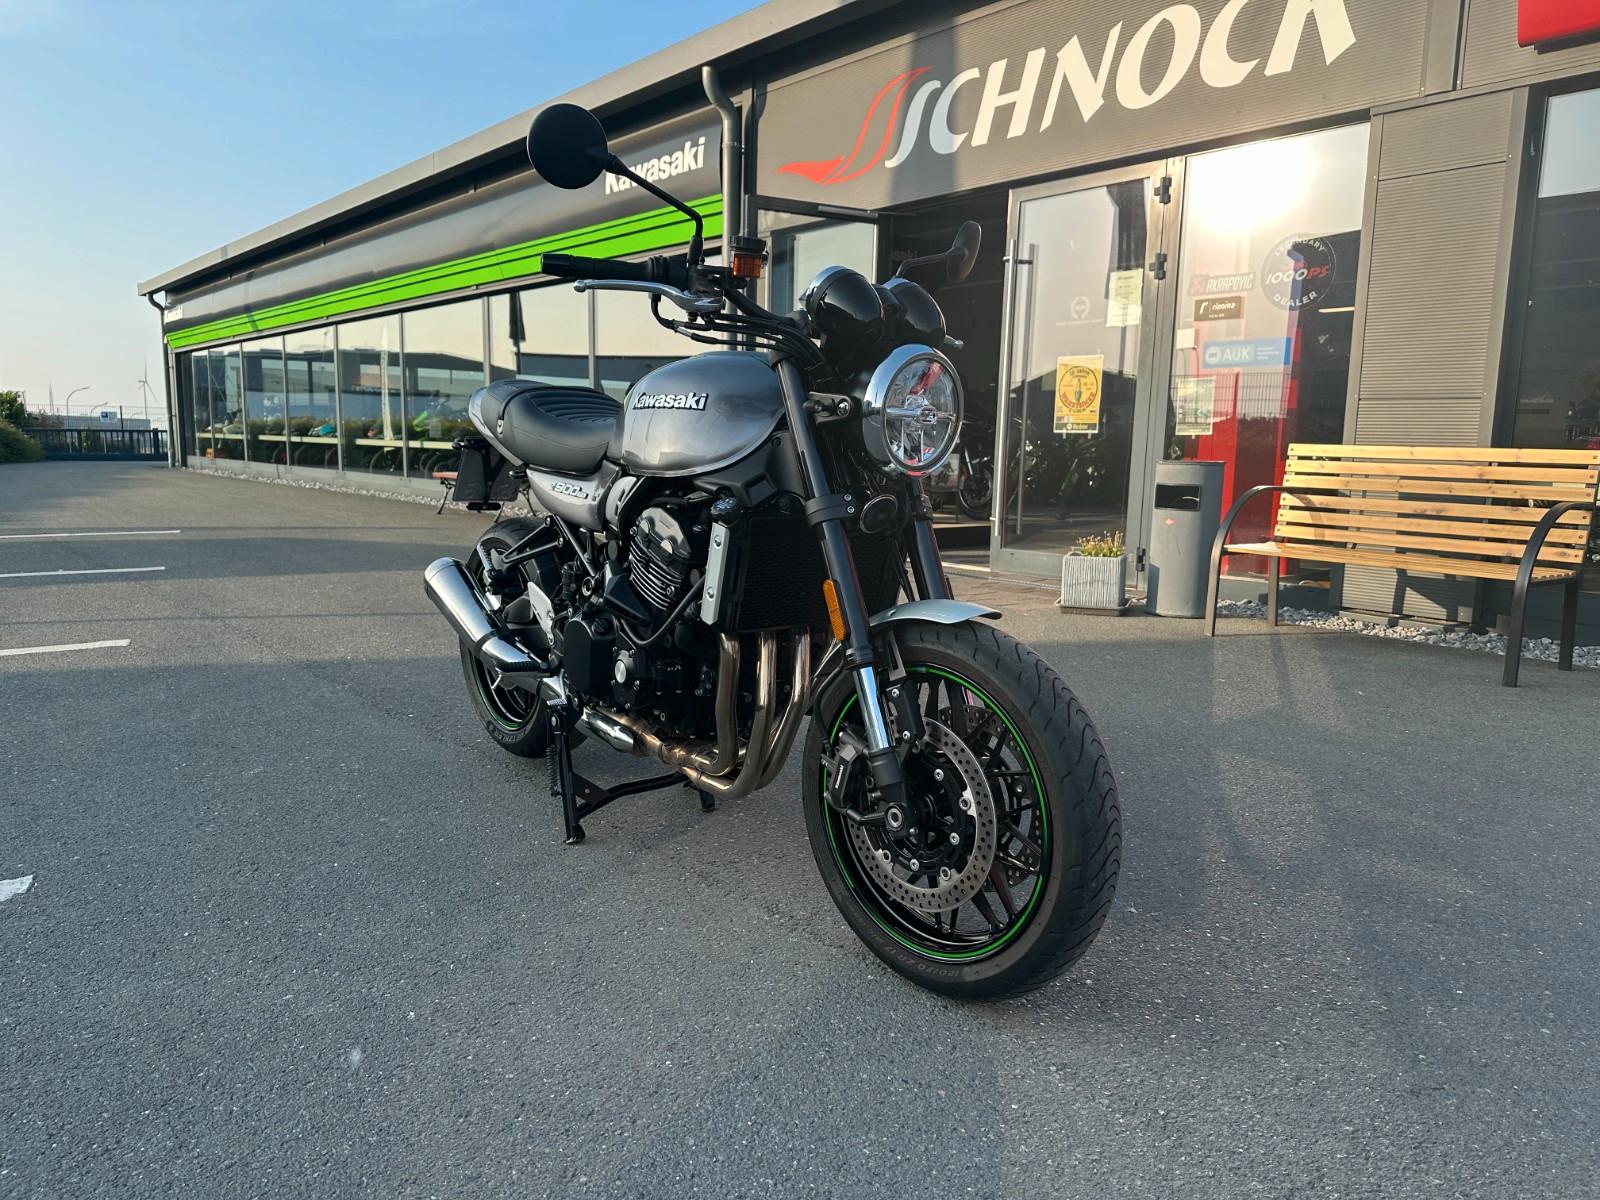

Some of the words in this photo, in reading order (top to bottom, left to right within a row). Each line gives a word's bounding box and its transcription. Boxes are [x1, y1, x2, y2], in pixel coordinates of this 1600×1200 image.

[885, 0, 1356, 168] SCHNOCK
[1212, 302, 1235, 310] rizoma
[1273, 291, 1318, 307] DEALER
[1222, 345, 1251, 362] AUK
[632, 391, 708, 411] Kawasaki
